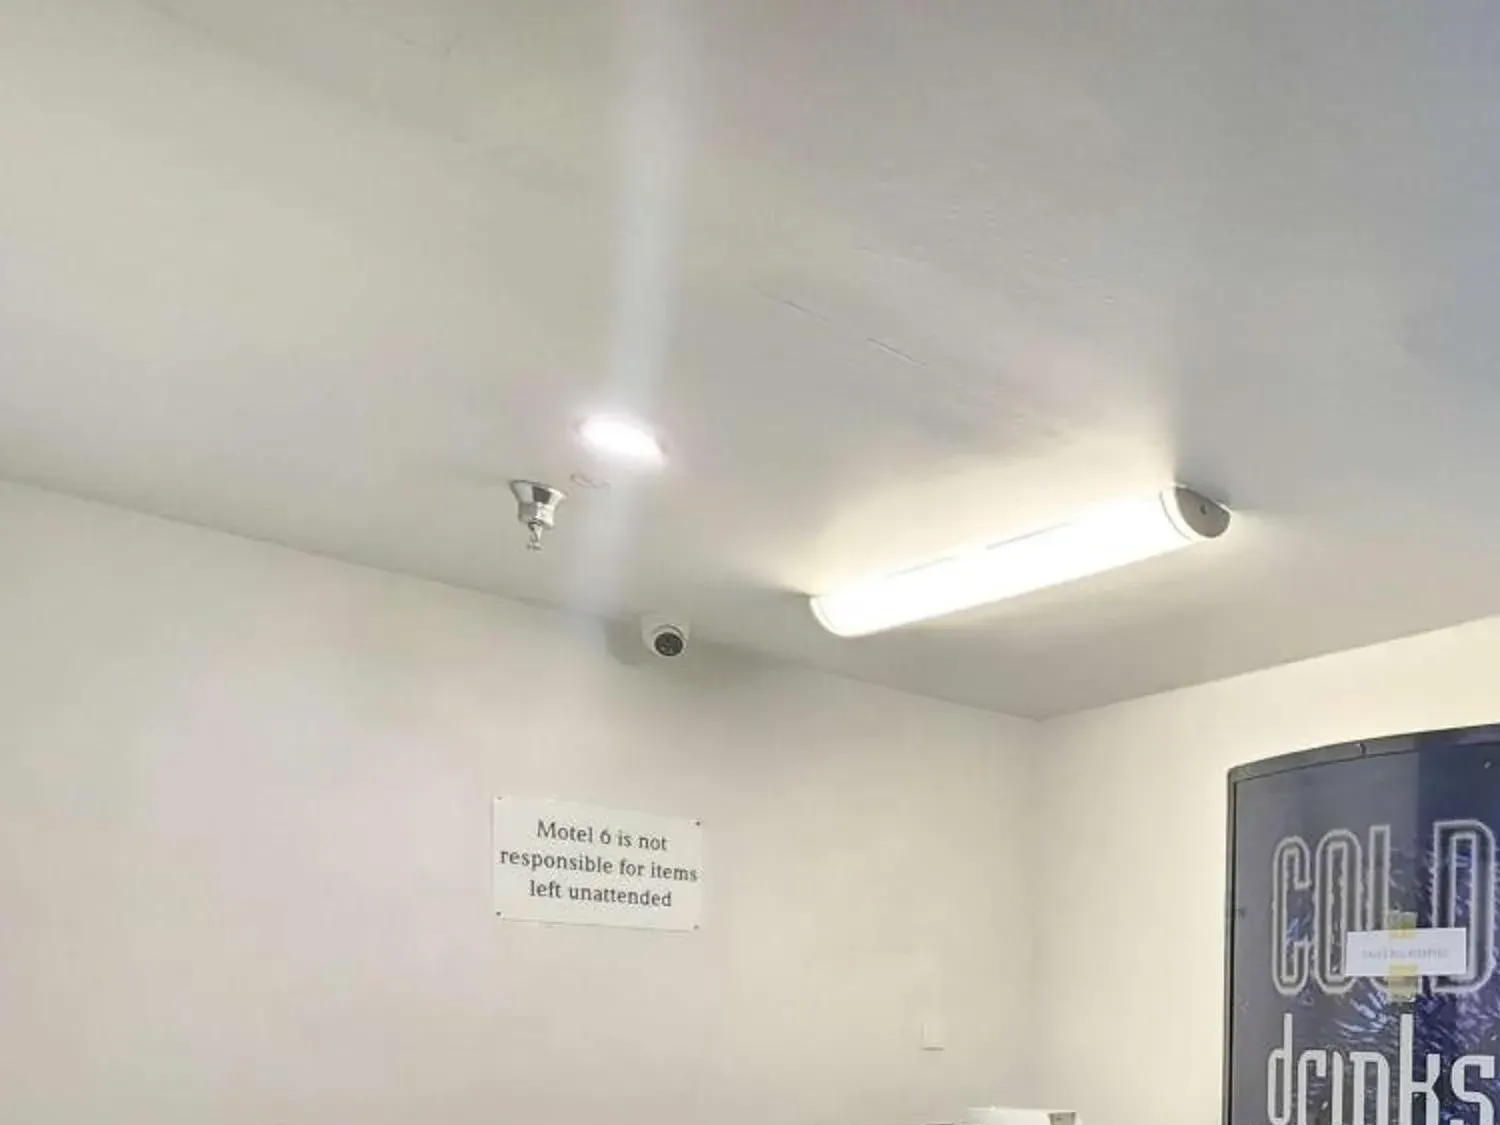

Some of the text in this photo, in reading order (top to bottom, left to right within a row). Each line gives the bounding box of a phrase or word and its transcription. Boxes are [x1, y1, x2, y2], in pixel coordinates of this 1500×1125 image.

[536, 819, 668, 851] Motel 6 is not
[499, 850, 698, 882] responsible for items
[529, 879, 672, 907] left unattended
[1272, 819, 1496, 995] COLD
